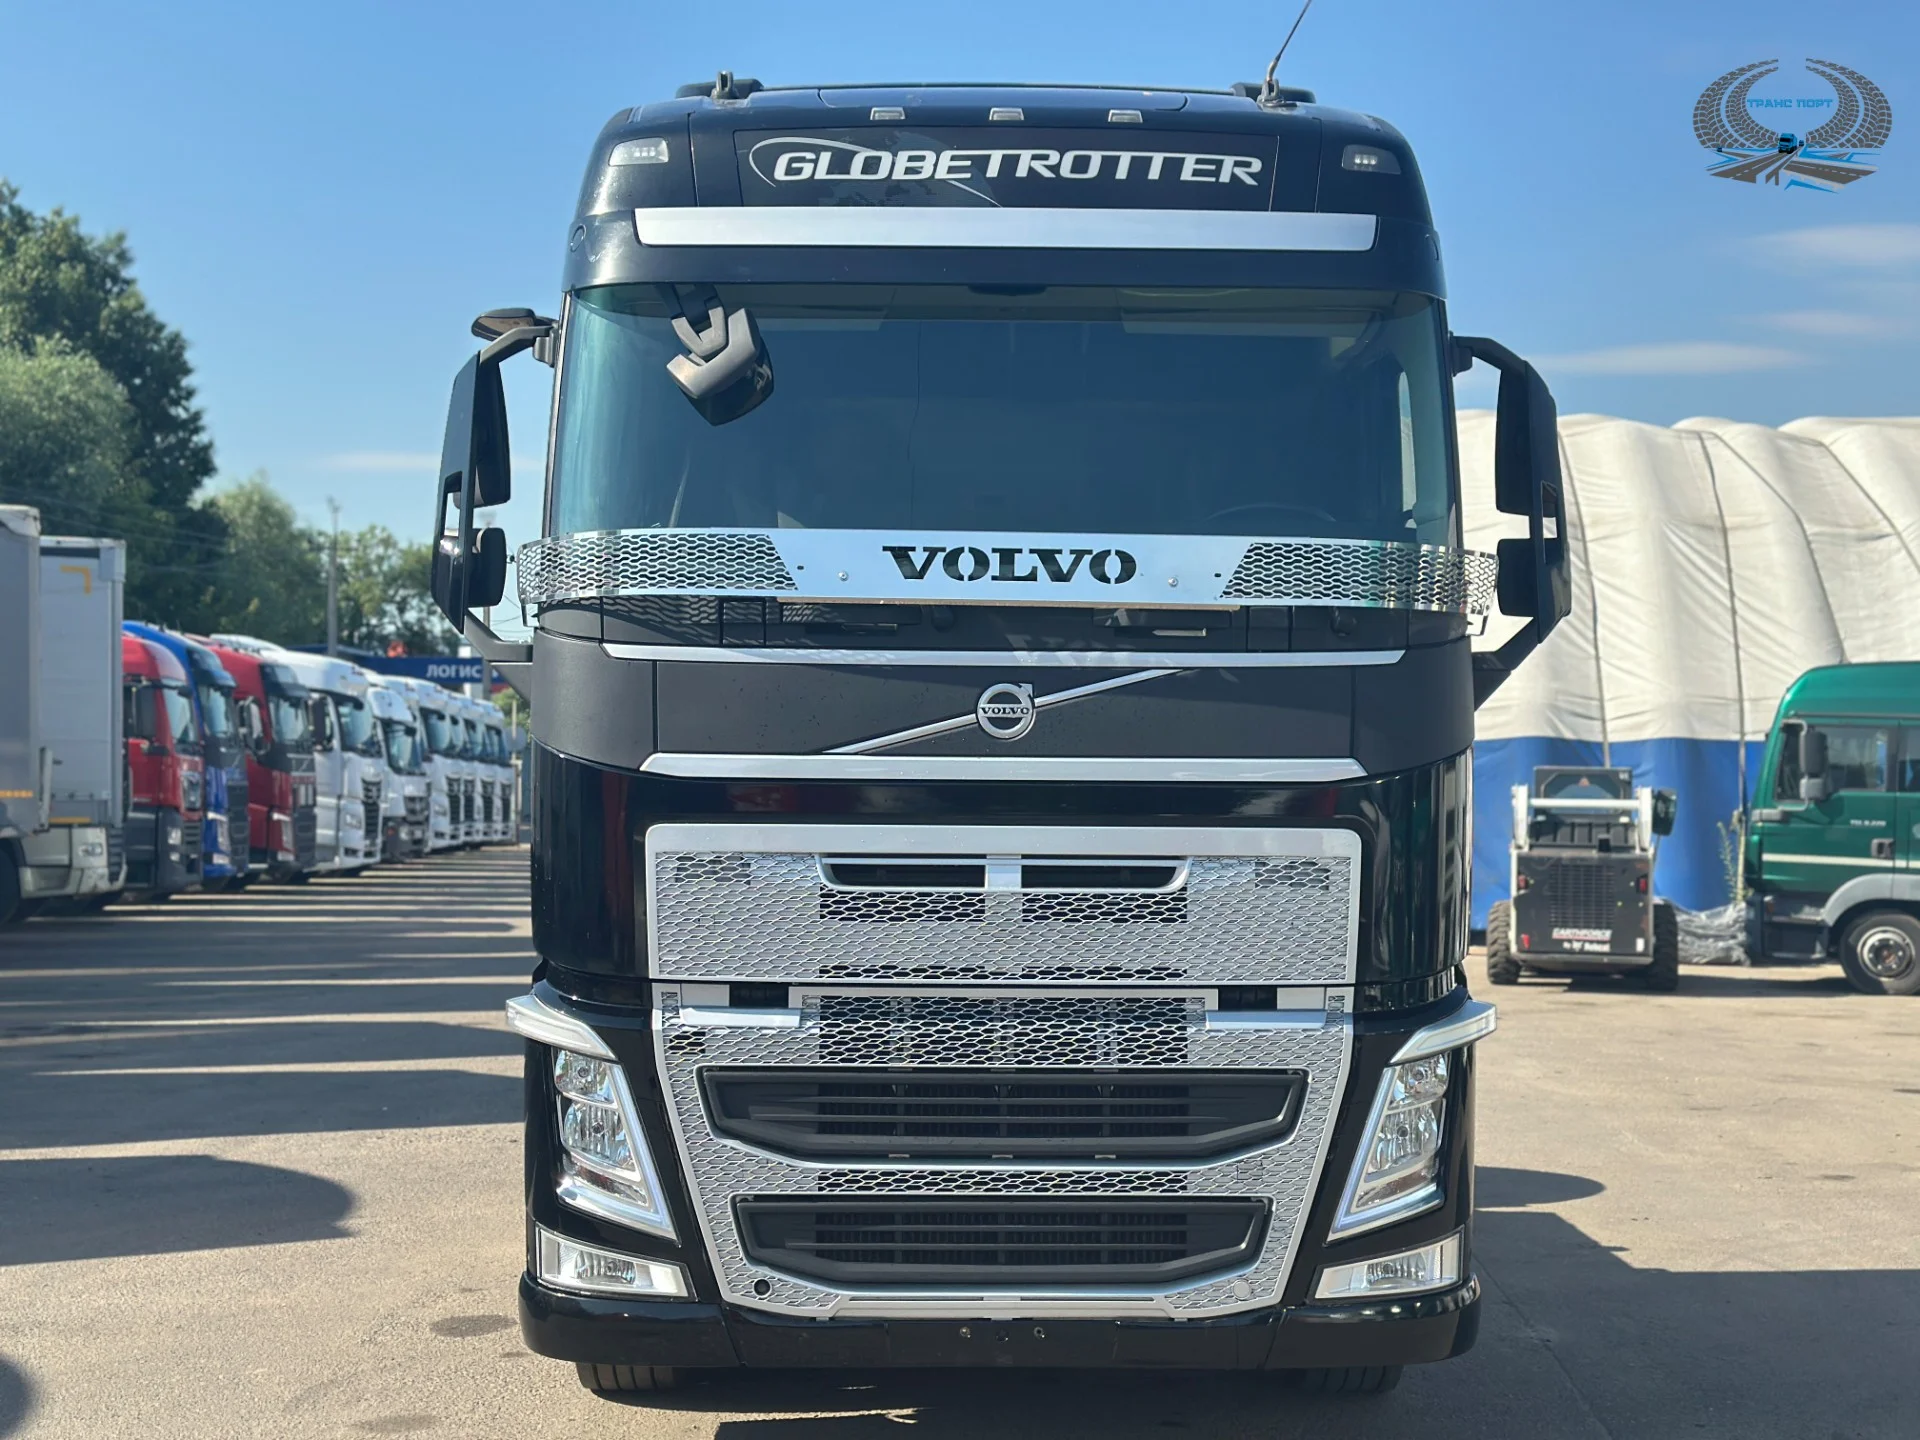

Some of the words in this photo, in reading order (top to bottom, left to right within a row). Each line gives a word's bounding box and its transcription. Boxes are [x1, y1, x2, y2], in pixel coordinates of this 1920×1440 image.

[773, 148, 1263, 186] GLOBETROTTER
[882, 545, 1137, 585] VOLVO
[426, 664, 499, 678] ЛОГИС
[980, 706, 1030, 717] VOLVO
